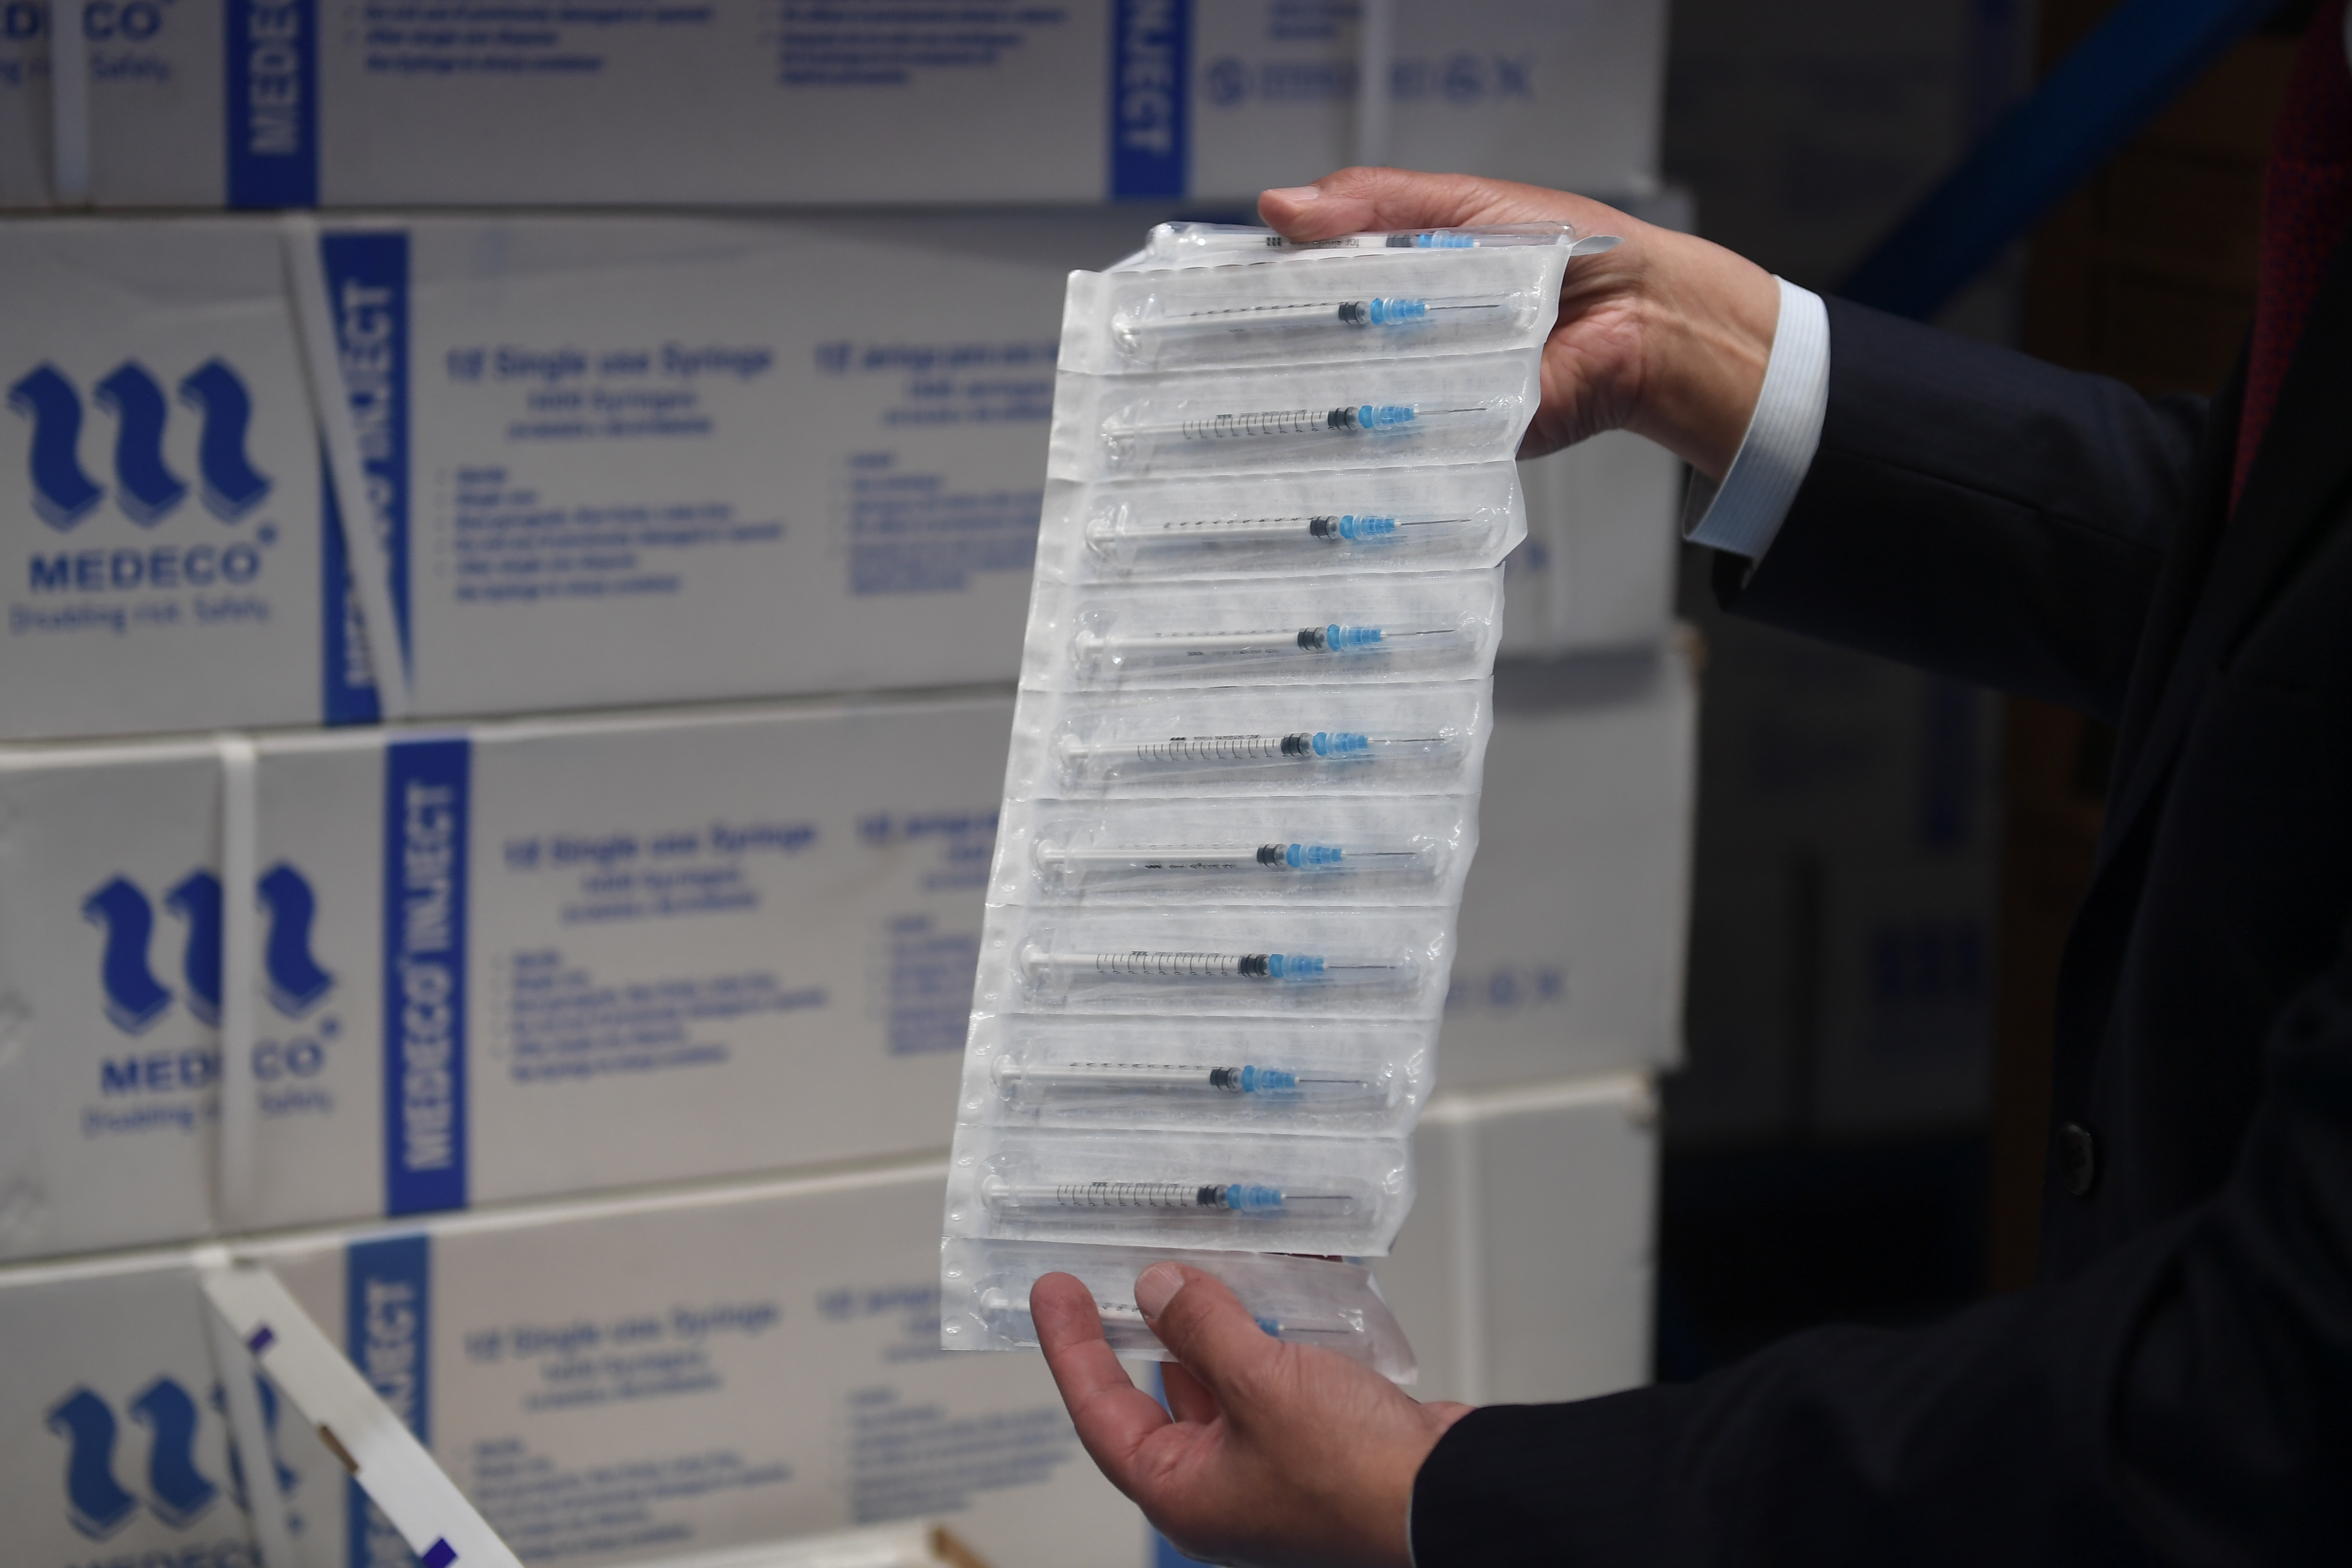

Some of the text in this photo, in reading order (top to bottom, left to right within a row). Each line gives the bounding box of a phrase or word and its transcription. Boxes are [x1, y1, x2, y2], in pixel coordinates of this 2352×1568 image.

[27, 542, 261, 593] MEDECO
[404, 780, 453, 1170] MEDECO INJECT
[100, 1041, 325, 1095] MEDCO
